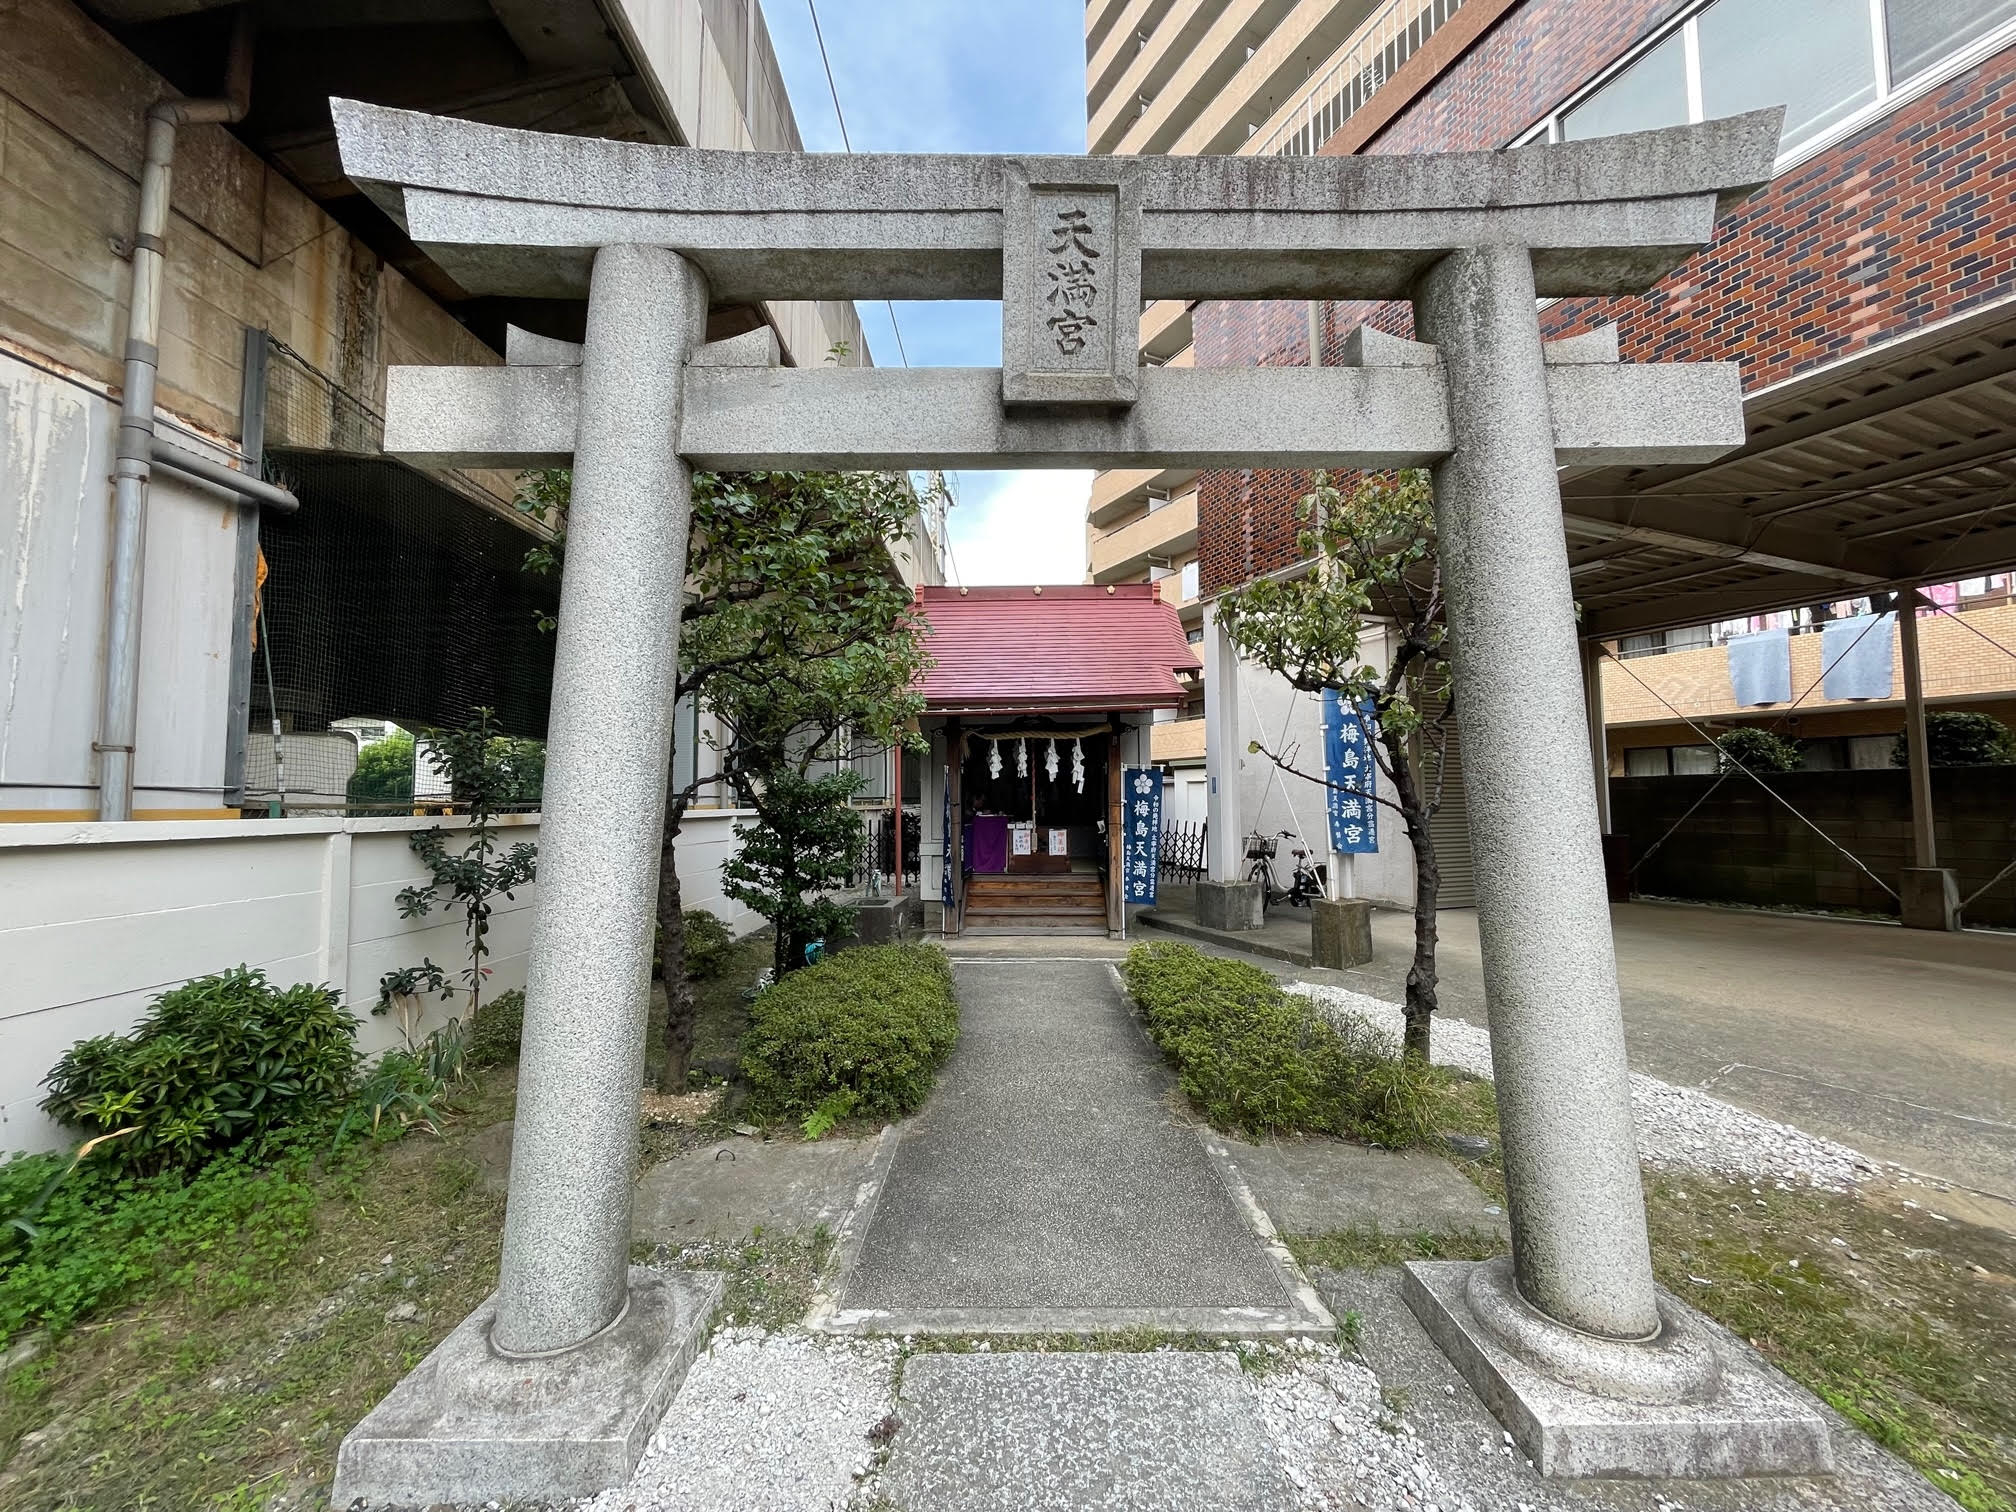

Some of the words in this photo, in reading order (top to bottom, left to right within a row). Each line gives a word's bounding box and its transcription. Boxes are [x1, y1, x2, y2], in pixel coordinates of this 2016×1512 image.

[1047, 209, 1100, 355] 天満宮
[1339, 723, 1364, 844] 梅島天満宮
[1133, 799, 1151, 897] 梅島天満宮
